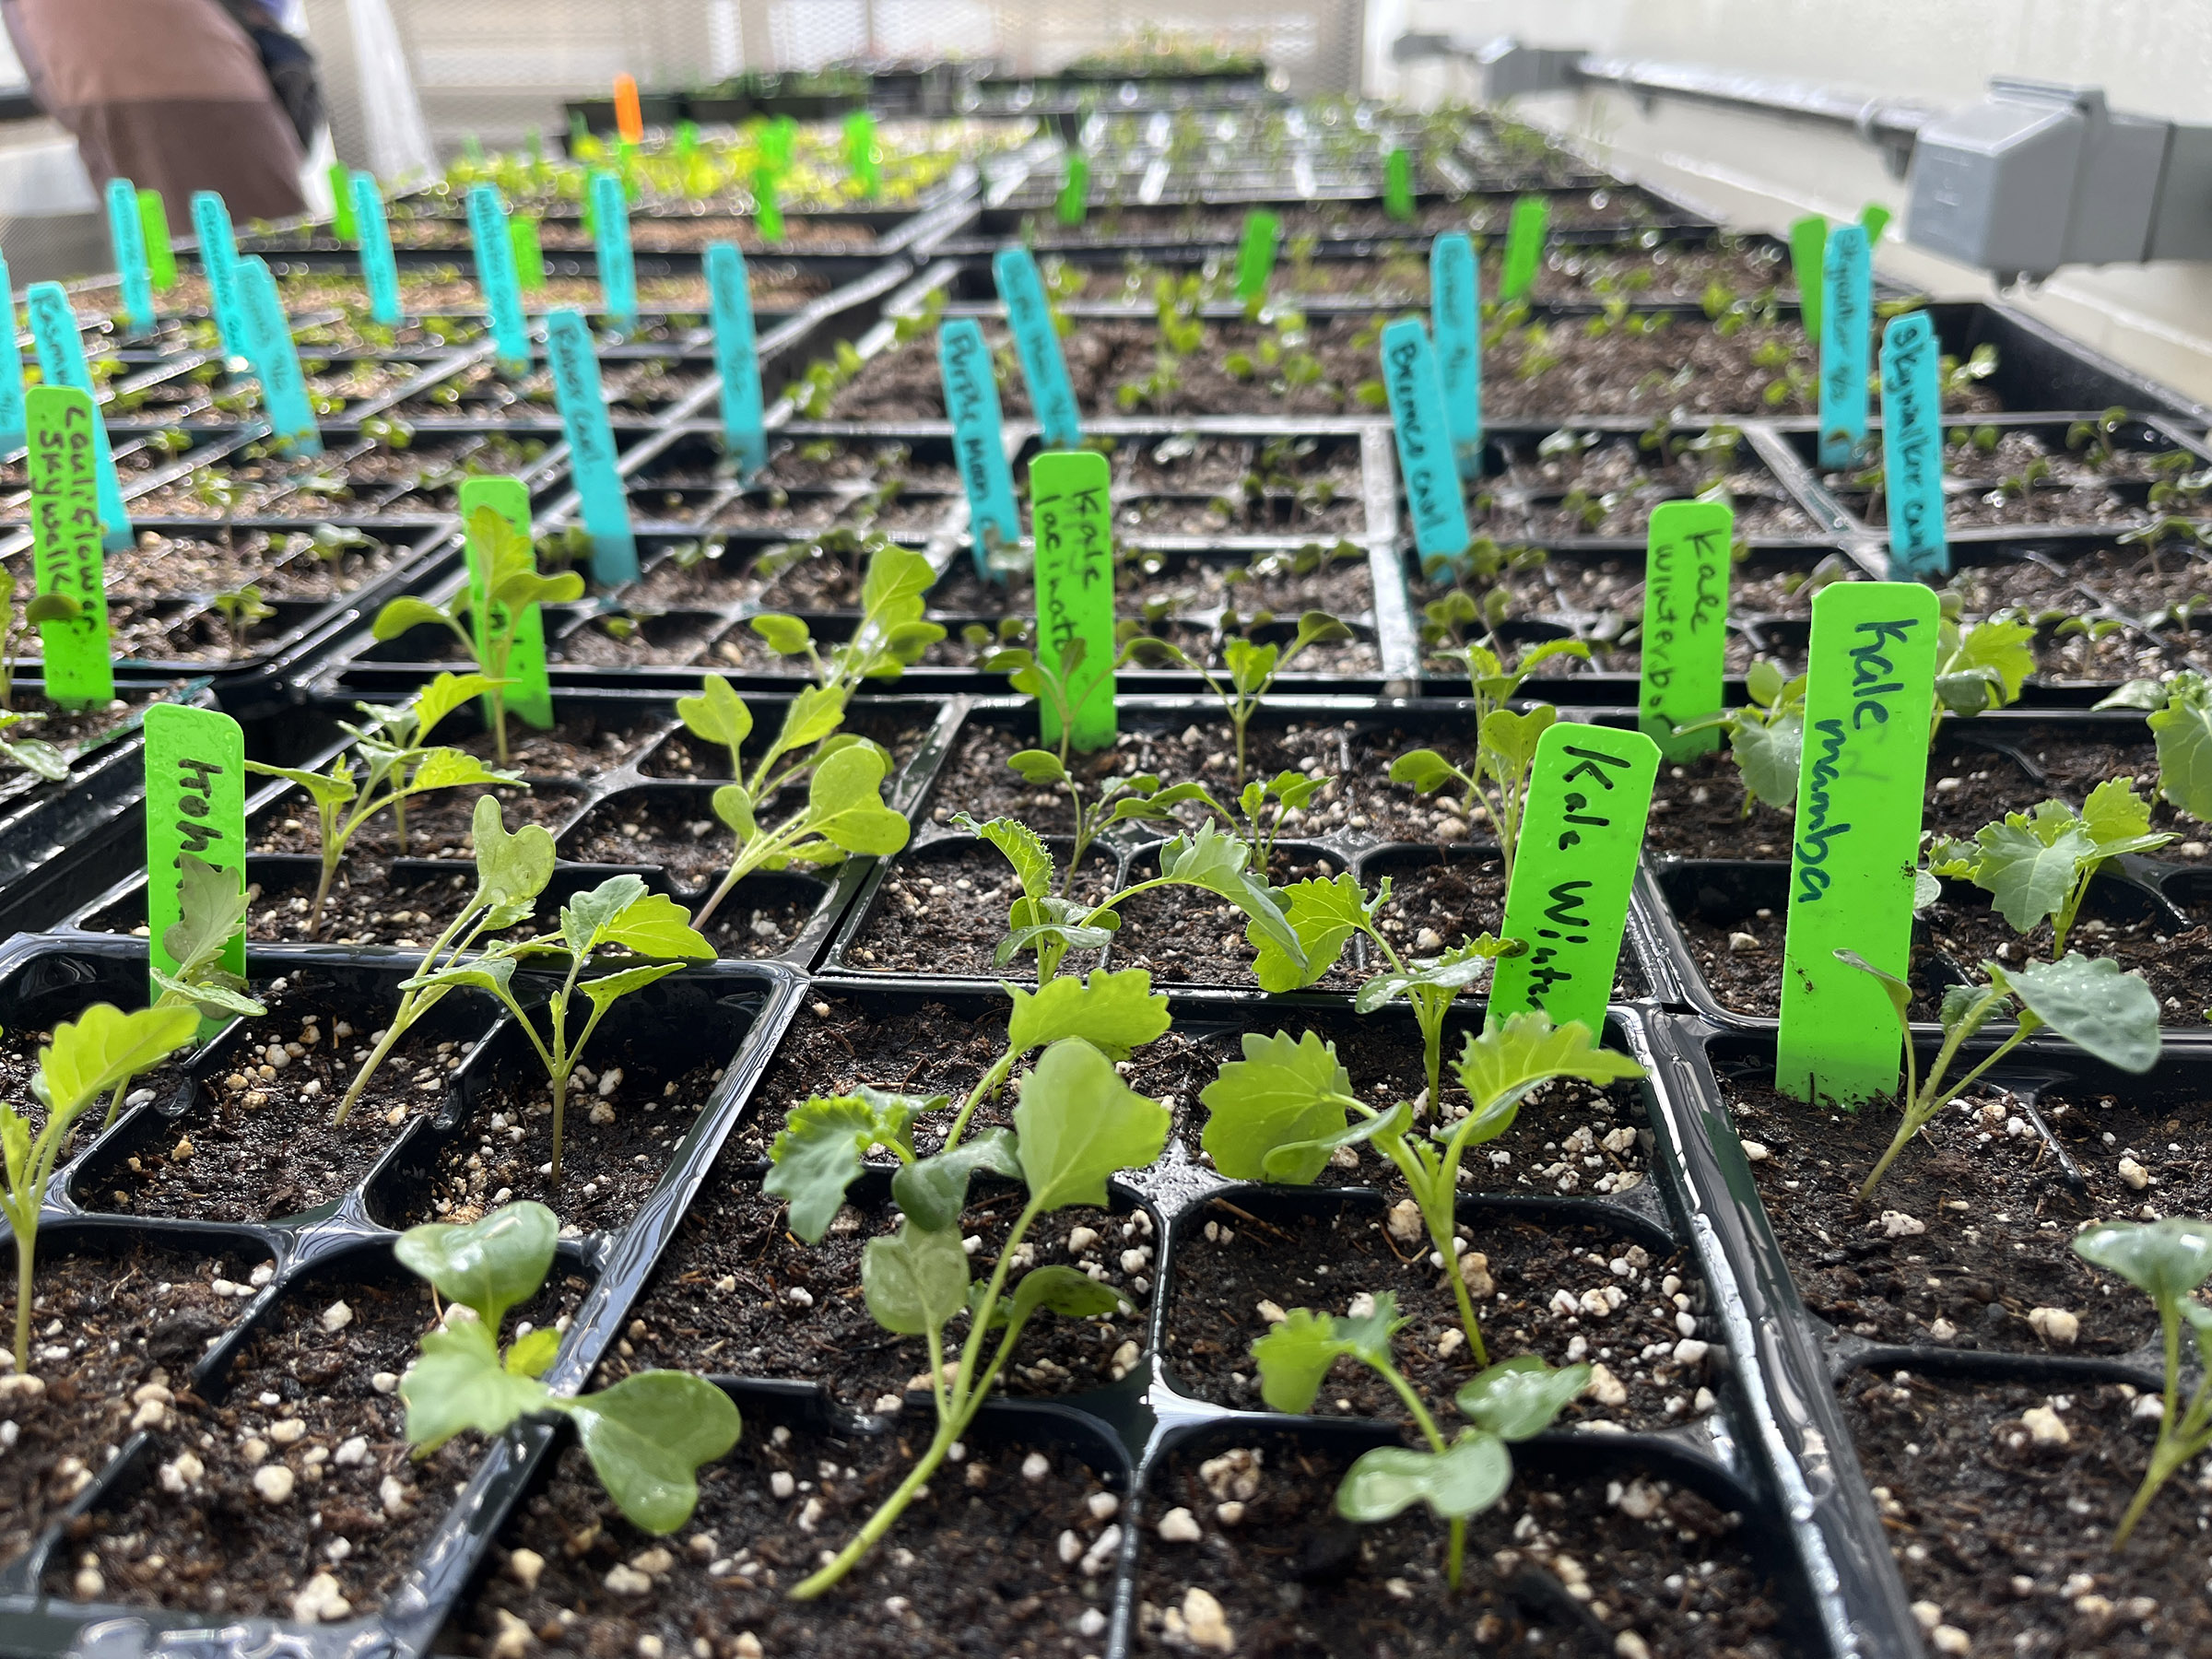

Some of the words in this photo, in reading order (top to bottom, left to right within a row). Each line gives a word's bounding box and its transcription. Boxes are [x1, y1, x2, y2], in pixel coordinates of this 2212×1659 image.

[31, 429, 72, 594] Skywalk
[1072, 486, 1104, 591] Kale
[1682, 528, 1725, 636] Kale
[1848, 618, 1920, 730] Kale
[1558, 745, 1631, 851] Kale
